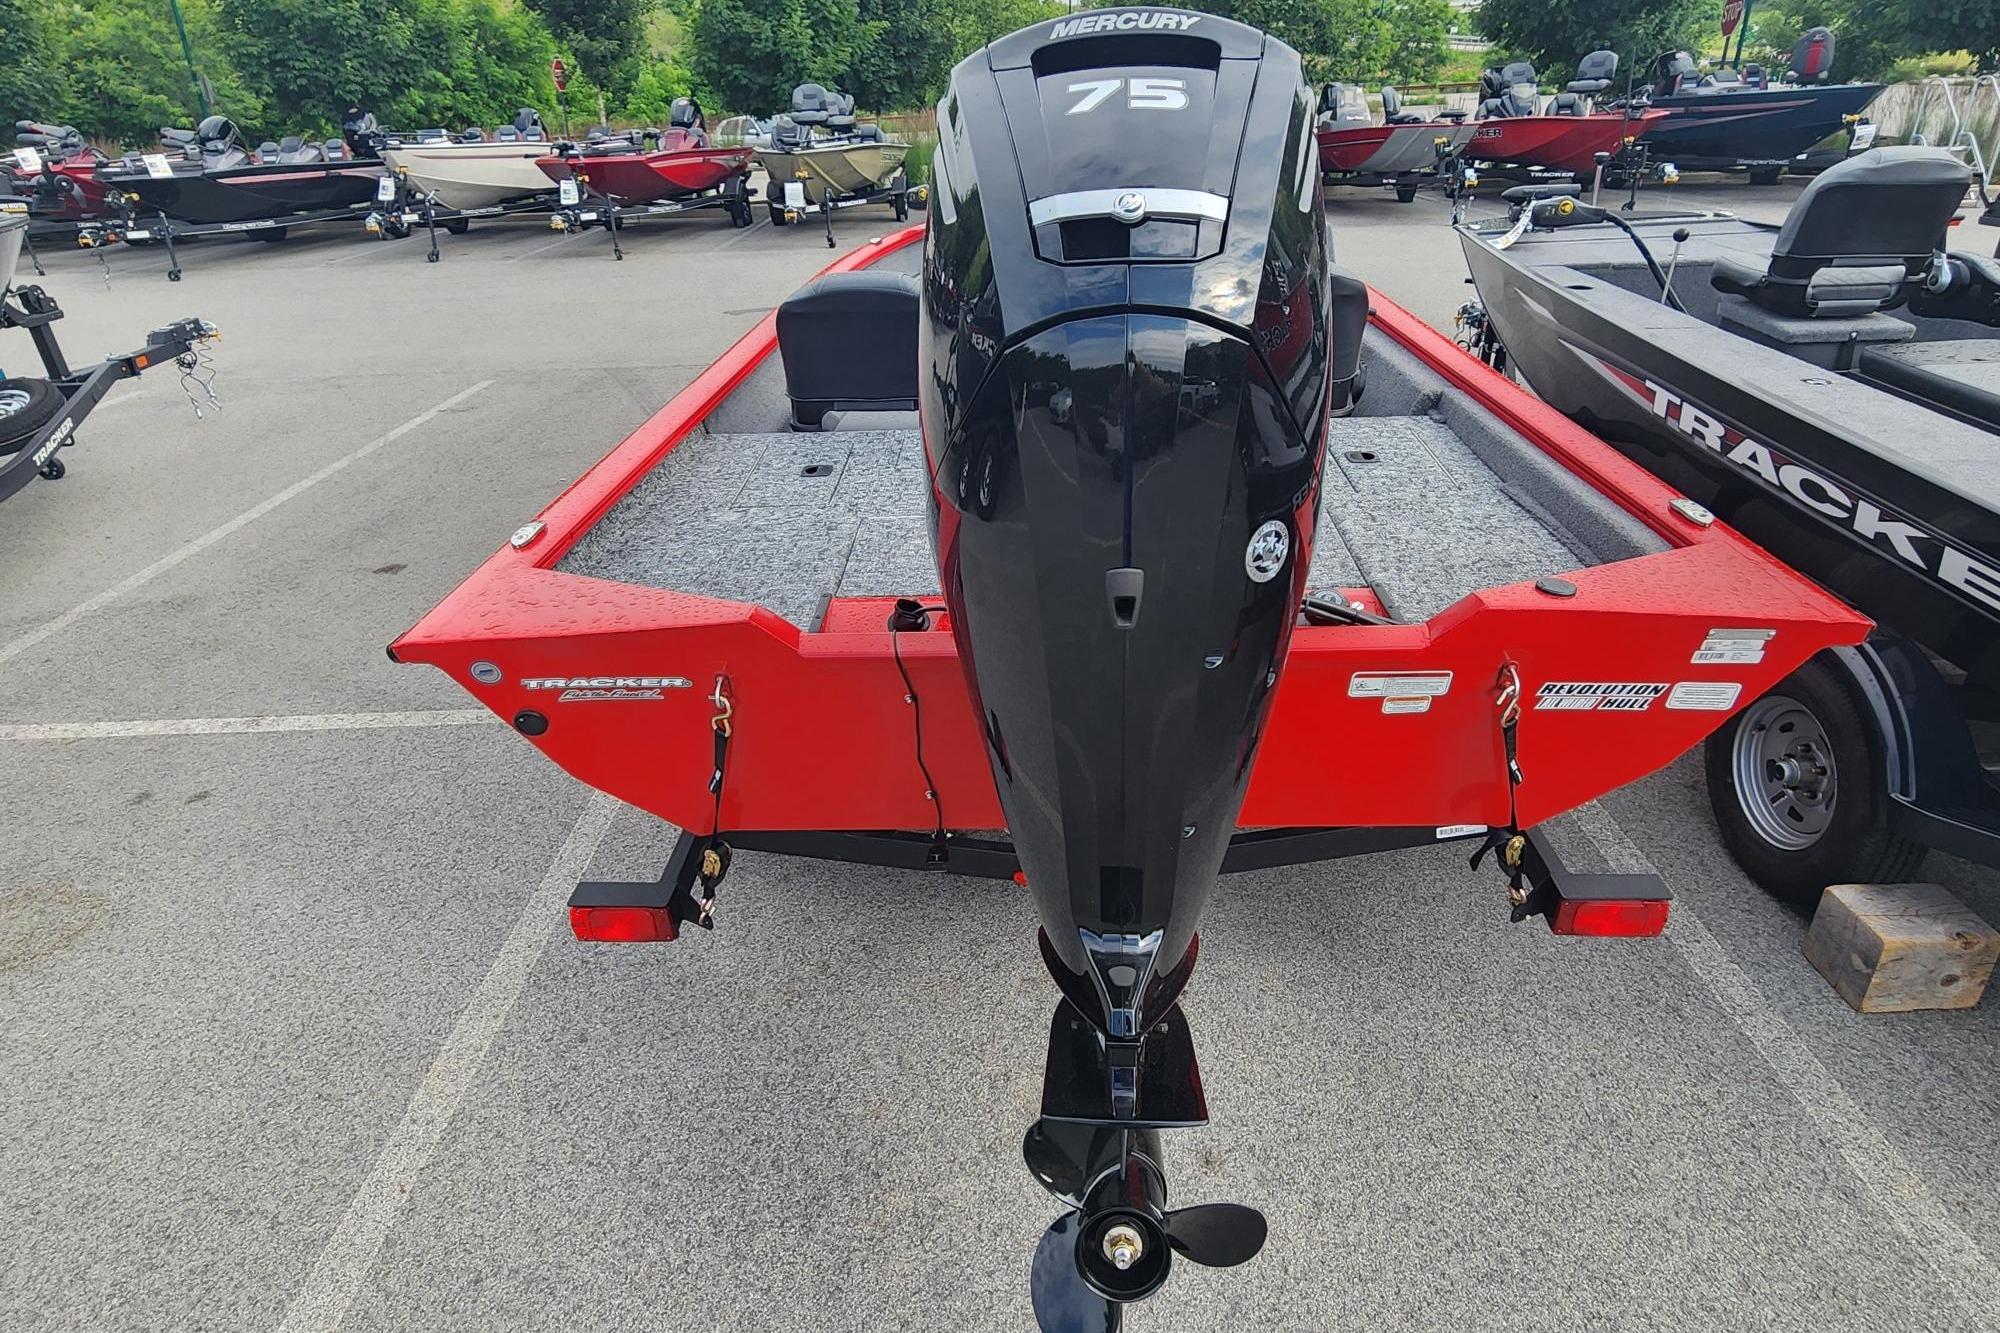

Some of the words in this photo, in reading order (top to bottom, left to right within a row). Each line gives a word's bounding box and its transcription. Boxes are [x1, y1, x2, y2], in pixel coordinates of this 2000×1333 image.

[1723, 1, 1743, 22] STOP
[1050, 12, 1201, 40] MERCURY
[1065, 78, 1189, 116] 75
[32, 416, 74, 466] TRACKER
[522, 676, 688, 690] TRACKER
[1539, 684, 1667, 696] REVOLUTION
[564, 690, 589, 698] Fish
[590, 690, 609, 698] the
[1601, 697, 1652, 710] HULL
